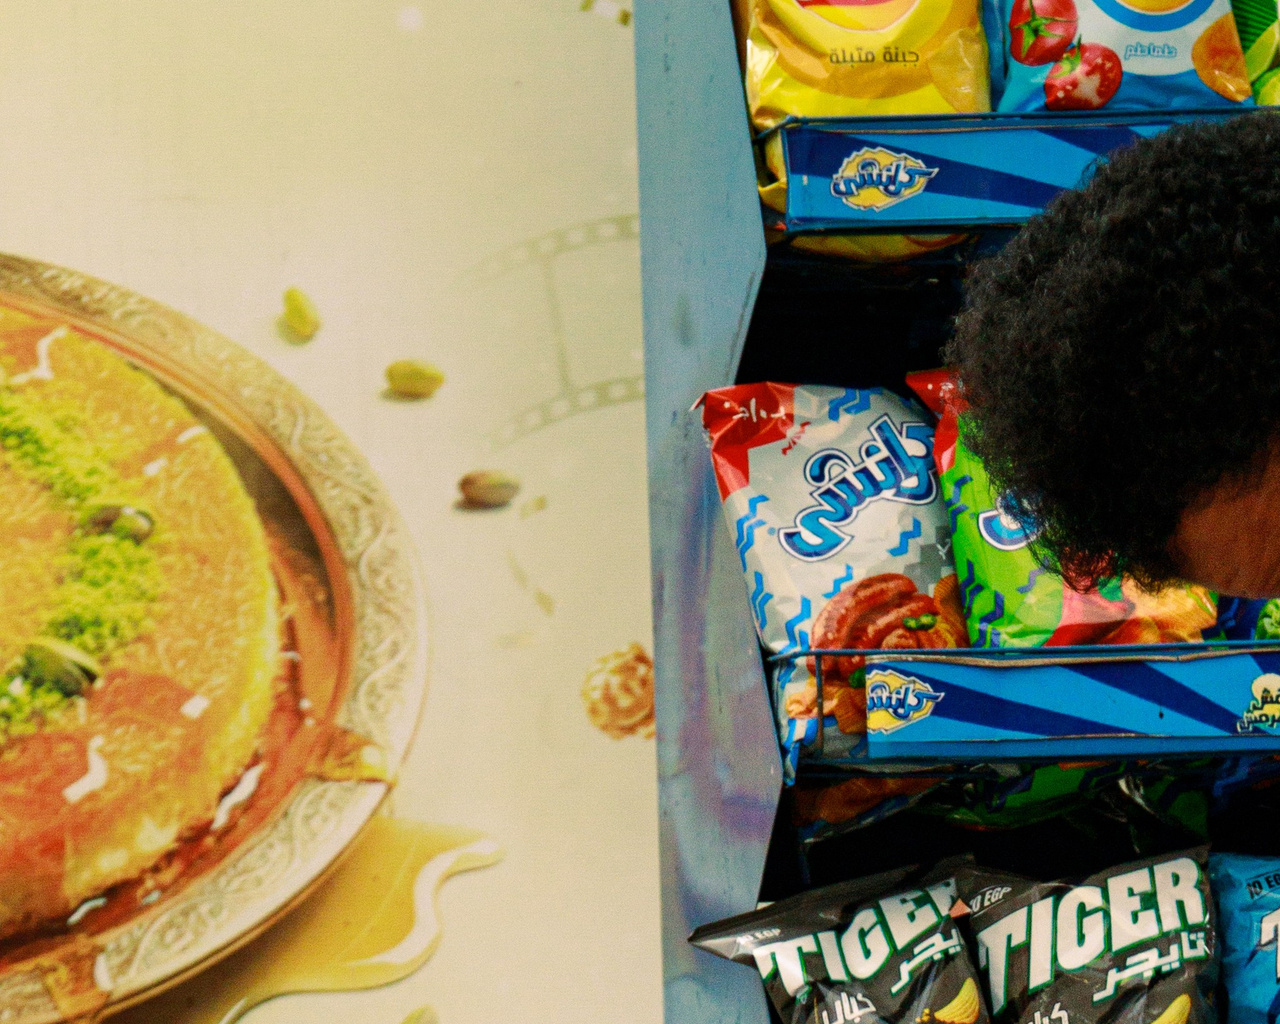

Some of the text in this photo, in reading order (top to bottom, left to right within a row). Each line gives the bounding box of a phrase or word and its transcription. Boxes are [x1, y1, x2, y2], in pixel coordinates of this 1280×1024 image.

[829, 46, 920, 69] جبنة متبلة
[983, 886, 1012, 907] EGP
[889, 927, 963, 996] يجر
[976, 856, 1206, 1016] TIGER
[1092, 931, 1207, 1003] تايجر
